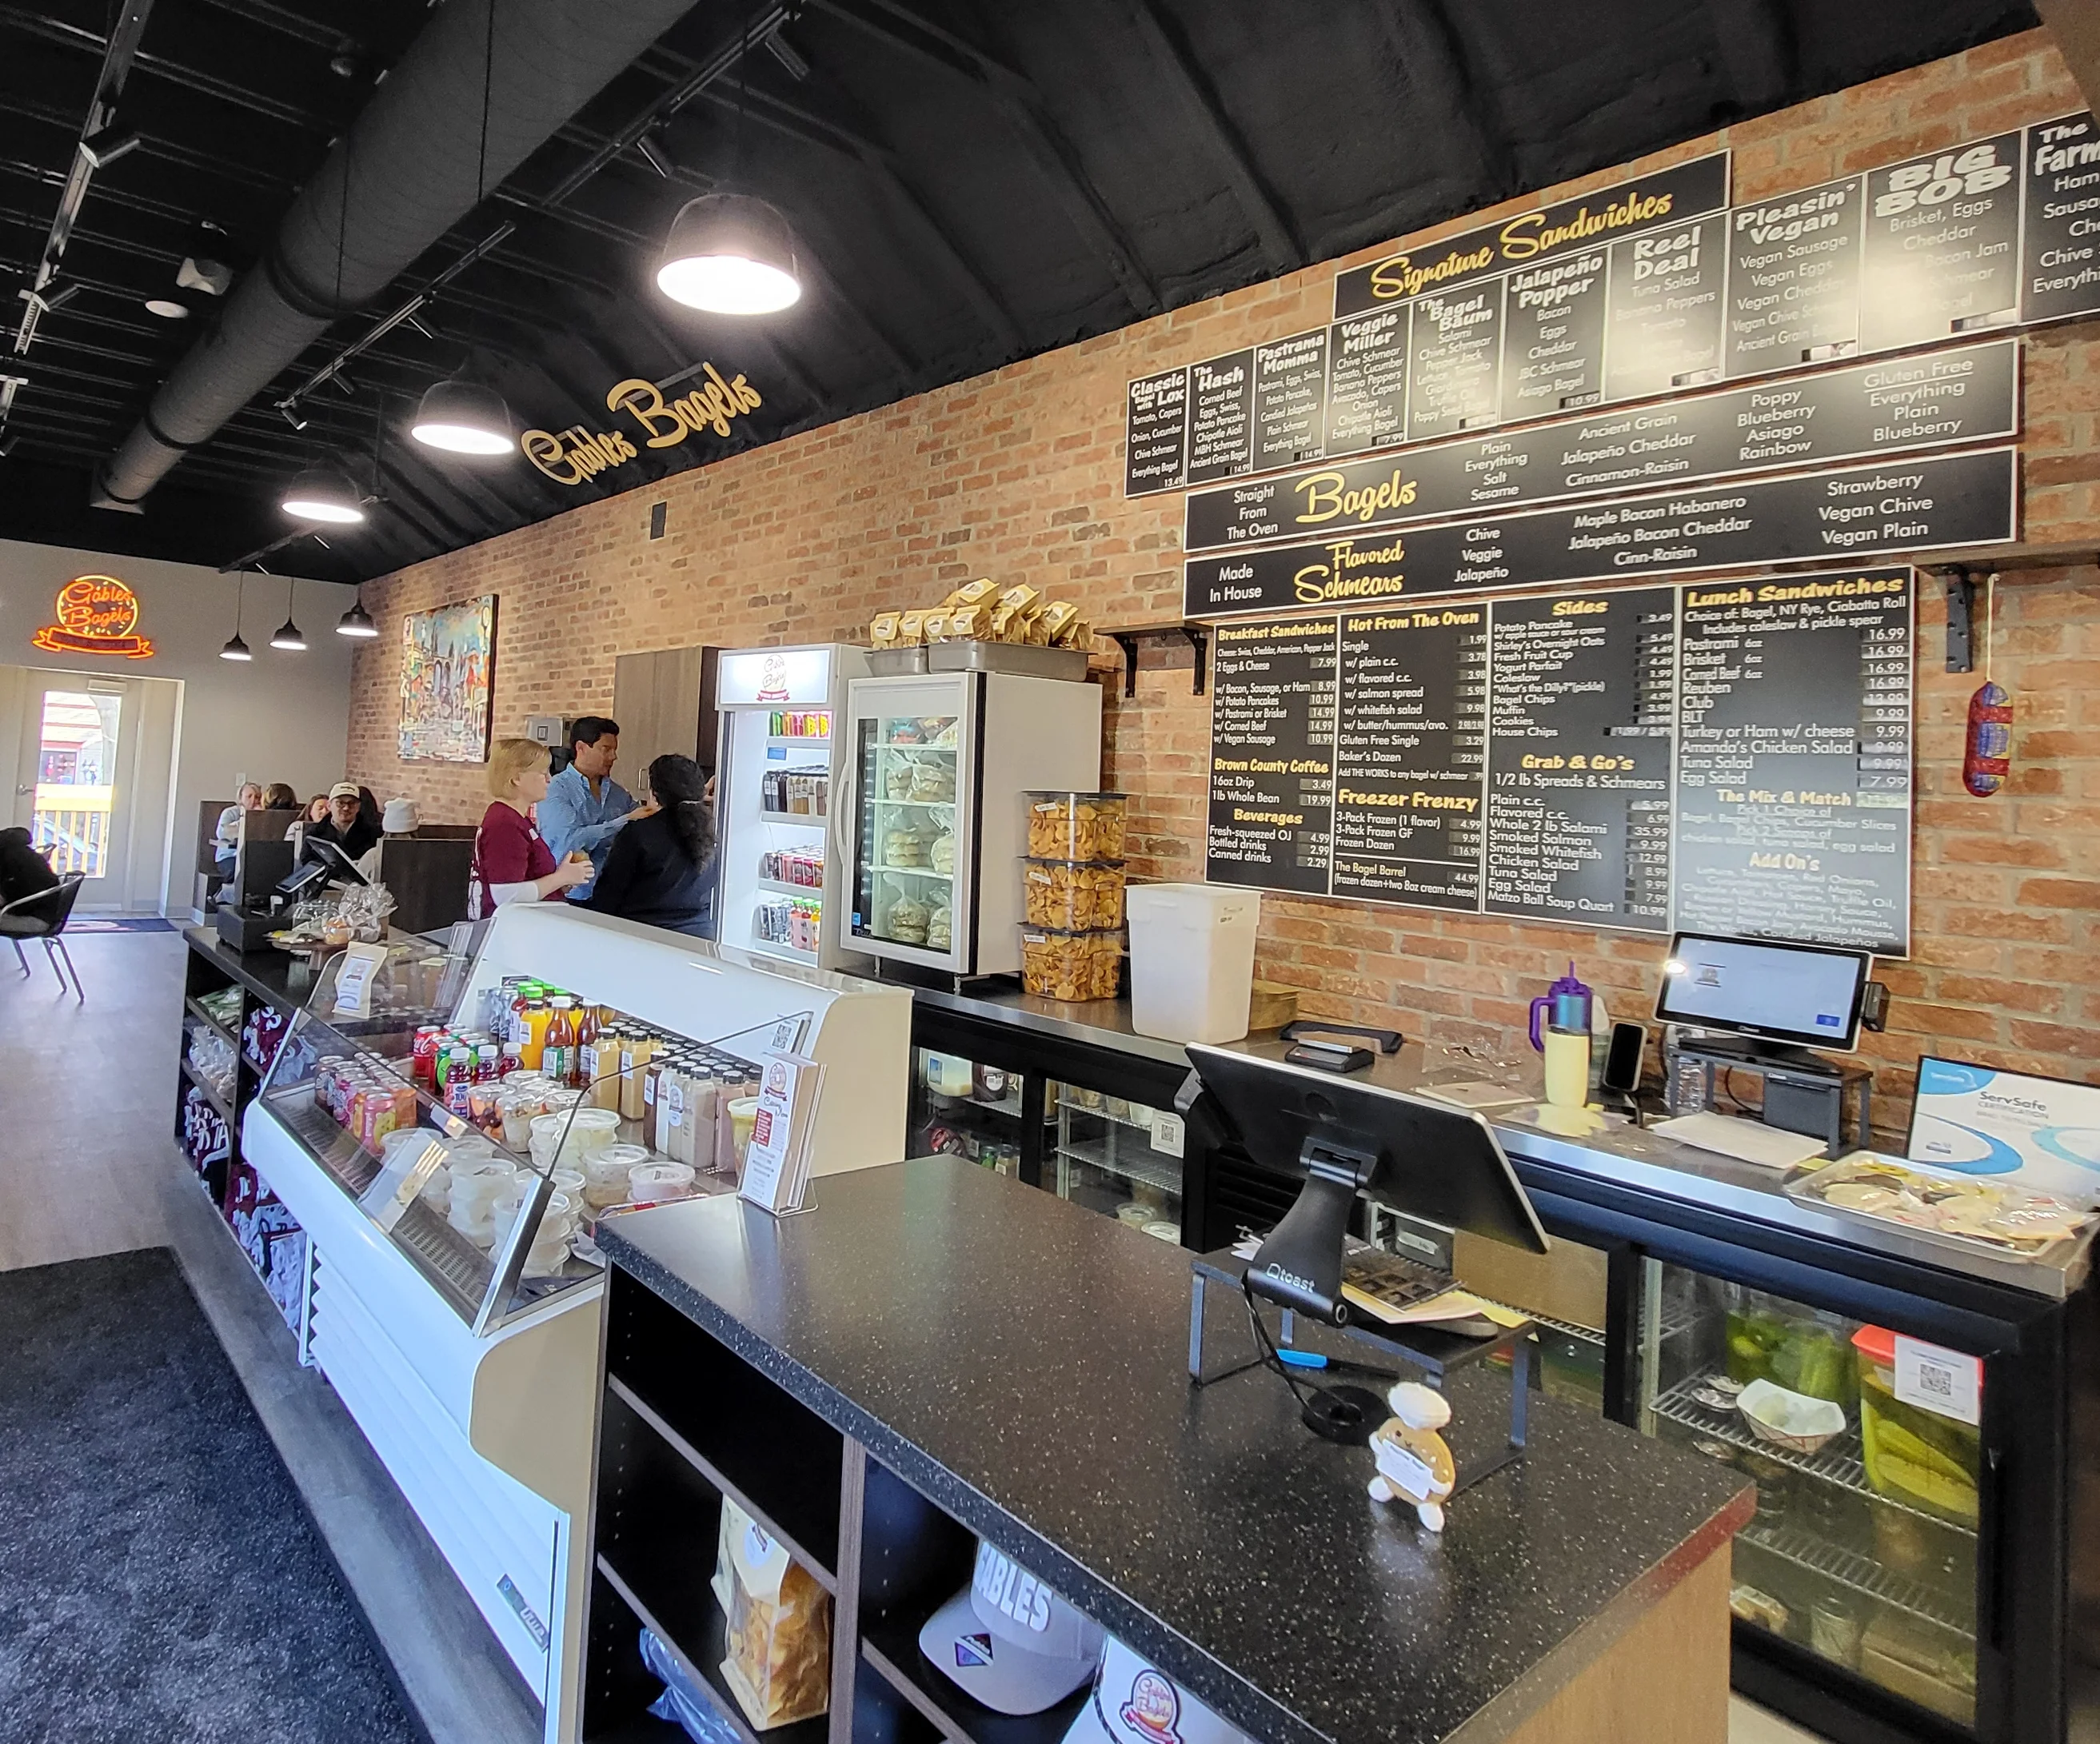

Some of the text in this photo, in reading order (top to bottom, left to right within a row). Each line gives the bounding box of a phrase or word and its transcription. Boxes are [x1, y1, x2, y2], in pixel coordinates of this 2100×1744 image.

[2039, 123, 2089, 144] The
[1889, 145, 1996, 189] BIG
[1874, 165, 2011, 218] BOB
[1735, 183, 1856, 233] Pleasin'
[1952, 197, 1993, 221] Eggs
[1749, 210, 1838, 245] Vegan
[1371, 192, 1673, 298] Signature Sandwiches
[1634, 225, 1702, 261] Reel
[1740, 235, 1848, 269] Vegan Sausage
[1511, 254, 1603, 293] Jalapeño
[1634, 251, 1699, 281] Deal
[1752, 259, 1834, 288] Vegan Eggs
[1519, 277, 1595, 309] Popper
[1419, 298, 1445, 313] The
[1430, 295, 1484, 323] Bagel
[1536, 305, 1571, 321] Bacon
[1342, 313, 1399, 339] Veggie
[1439, 309, 1493, 332] Baum
[1343, 331, 1395, 353] Miller
[1540, 324, 1567, 340] Eggs
[1259, 334, 1325, 363] Pastrama
[1337, 346, 1401, 369] Chive Schmear
[1528, 341, 1577, 359] Cheddar
[1194, 366, 1212, 377] The
[1264, 350, 1318, 374] Momma
[1364, 357, 1403, 374] Cucumber
[1198, 366, 1244, 392] Hash
[1333, 371, 1401, 394] Banana Peppers
[1863, 358, 1974, 388] Gluten Free
[1131, 373, 1185, 397] Classic
[1227, 385, 1243, 399] Beef
[1372, 383, 1402, 401] Capers
[1870, 381, 1966, 408] Everything
[1157, 389, 1185, 406] Lox
[1353, 399, 1379, 411] Onion
[1751, 389, 1802, 409] Poppy
[1738, 405, 1816, 428] Blueberry
[1894, 403, 1938, 421] Plain
[521, 361, 761, 485] Gables Bagels
[1332, 419, 1398, 441] Everything Bagel
[1579, 413, 1677, 441] Ancient Grain
[1746, 423, 1804, 443] Asiago
[1873, 418, 1962, 442] Blueberry
[1384, 433, 1403, 444] 7.99
[1481, 441, 1511, 455] Plain
[1560, 433, 1696, 466] Jalapeño Cheddar
[1739, 440, 1811, 461] Rainbow
[1465, 453, 1528, 474] Everything
[1564, 458, 1690, 488] Cinnamon-Raisin
[1483, 472, 1507, 485] Salt
[1827, 473, 1923, 497] Strawberry
[1233, 486, 1275, 504] Straight
[1294, 469, 1418, 523] Bagels
[1471, 485, 1519, 501] Sesame
[1239, 505, 1267, 520] From
[1574, 496, 1747, 530] Maple Bacon Habanero
[1819, 495, 1933, 522] Vegan Chive
[1227, 522, 1278, 539] The Oven
[1466, 528, 1500, 542] Chive
[1567, 517, 1753, 550] Jalapeño Bacon Cheddar
[1822, 521, 1929, 546] Vegan Plain
[1326, 540, 1404, 569] Flavored
[1462, 547, 1503, 562] Veggie
[1613, 545, 1698, 566] Cinn-Raisin
[1219, 566, 1253, 581] Made
[1453, 567, 1510, 582] Jalapeño
[64, 581, 133, 604] Gables
[1209, 586, 1262, 602] In House
[1293, 565, 1403, 604] Schmears
[1687, 578, 1904, 608] Lunch Sandwiches
[63, 607, 131, 627] Bagels
[1551, 601, 1609, 616] Sides
[1218, 623, 1335, 641] Breakfast Sandwiches
[1348, 612, 1479, 633] Hot From The Oven
[1343, 641, 1368, 653] Single
[1494, 650, 1573, 661] Fresh Fruit Cup
[1318, 658, 1336, 667] 7.99
[1682, 682, 1731, 693] Reuben
[1311, 695, 1333, 704] 10.99
[1682, 696, 1714, 708] Club
[1493, 716, 1534, 725] Cookies
[1339, 735, 1419, 747] Gluten Free Single
[1527, 728, 1559, 738] Chips
[1682, 724, 1855, 740] Turkey or Ham w/ cheese
[1215, 759, 1328, 775] Brown County Coffee
[1521, 754, 1635, 770] Grab & Go's
[1212, 776, 1255, 788] 16oz Drip
[1339, 788, 1479, 812] Freezer Frenzy
[1234, 809, 1303, 825] Beverages
[1335, 861, 1406, 876] The Bagel Barrel
[1489, 855, 1579, 871] Chicken Salad
[1488, 879, 1551, 893] Egg Salad
[1980, 1091, 2046, 1111] ServSafe
[1280, 1269, 1315, 1293] toast
